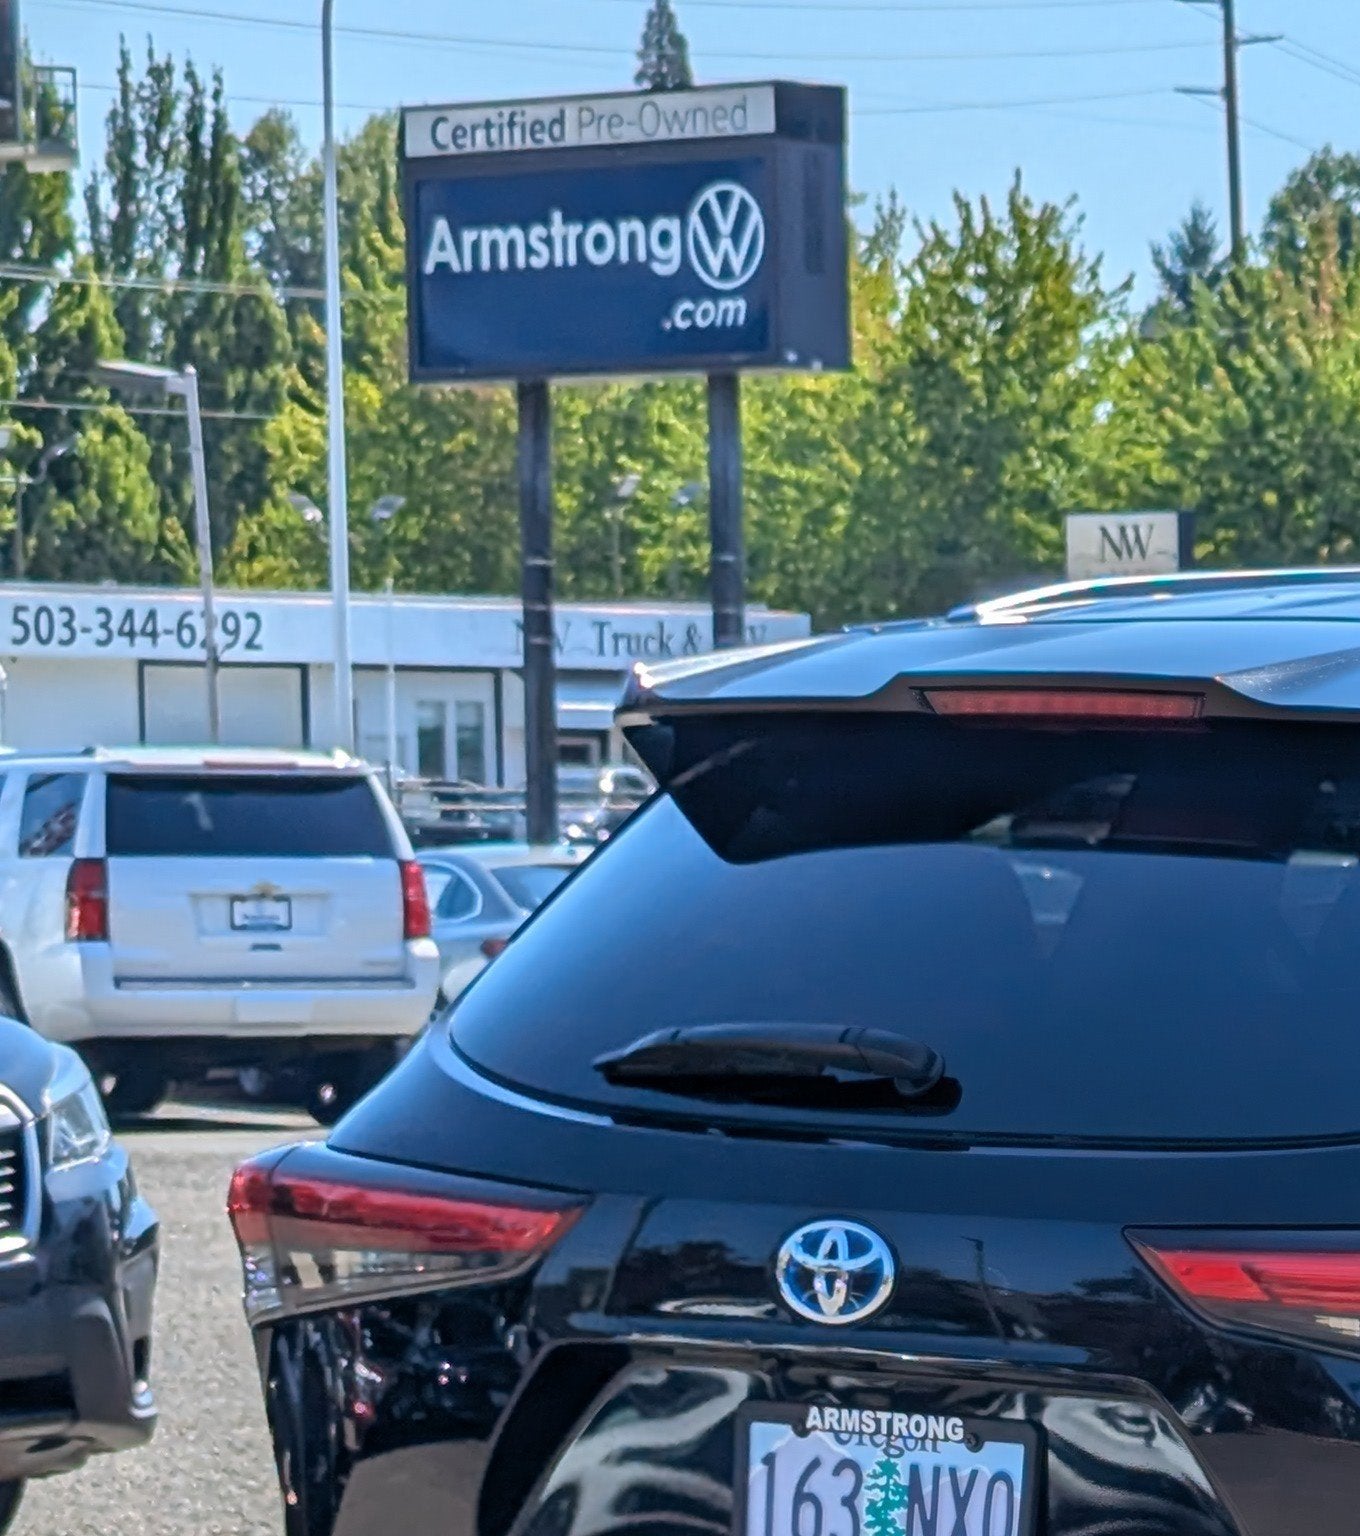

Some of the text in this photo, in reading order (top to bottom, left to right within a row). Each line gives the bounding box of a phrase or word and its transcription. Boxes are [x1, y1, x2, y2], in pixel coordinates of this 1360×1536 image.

[430, 95, 749, 151] Certified Pre-Owned
[423, 208, 683, 277] Armstrong
[661, 296, 747, 332] .com
[1098, 523, 1153, 563] NW
[591, 620, 675, 656] Truck
[805, 1406, 964, 1441] ARMSTRONG
